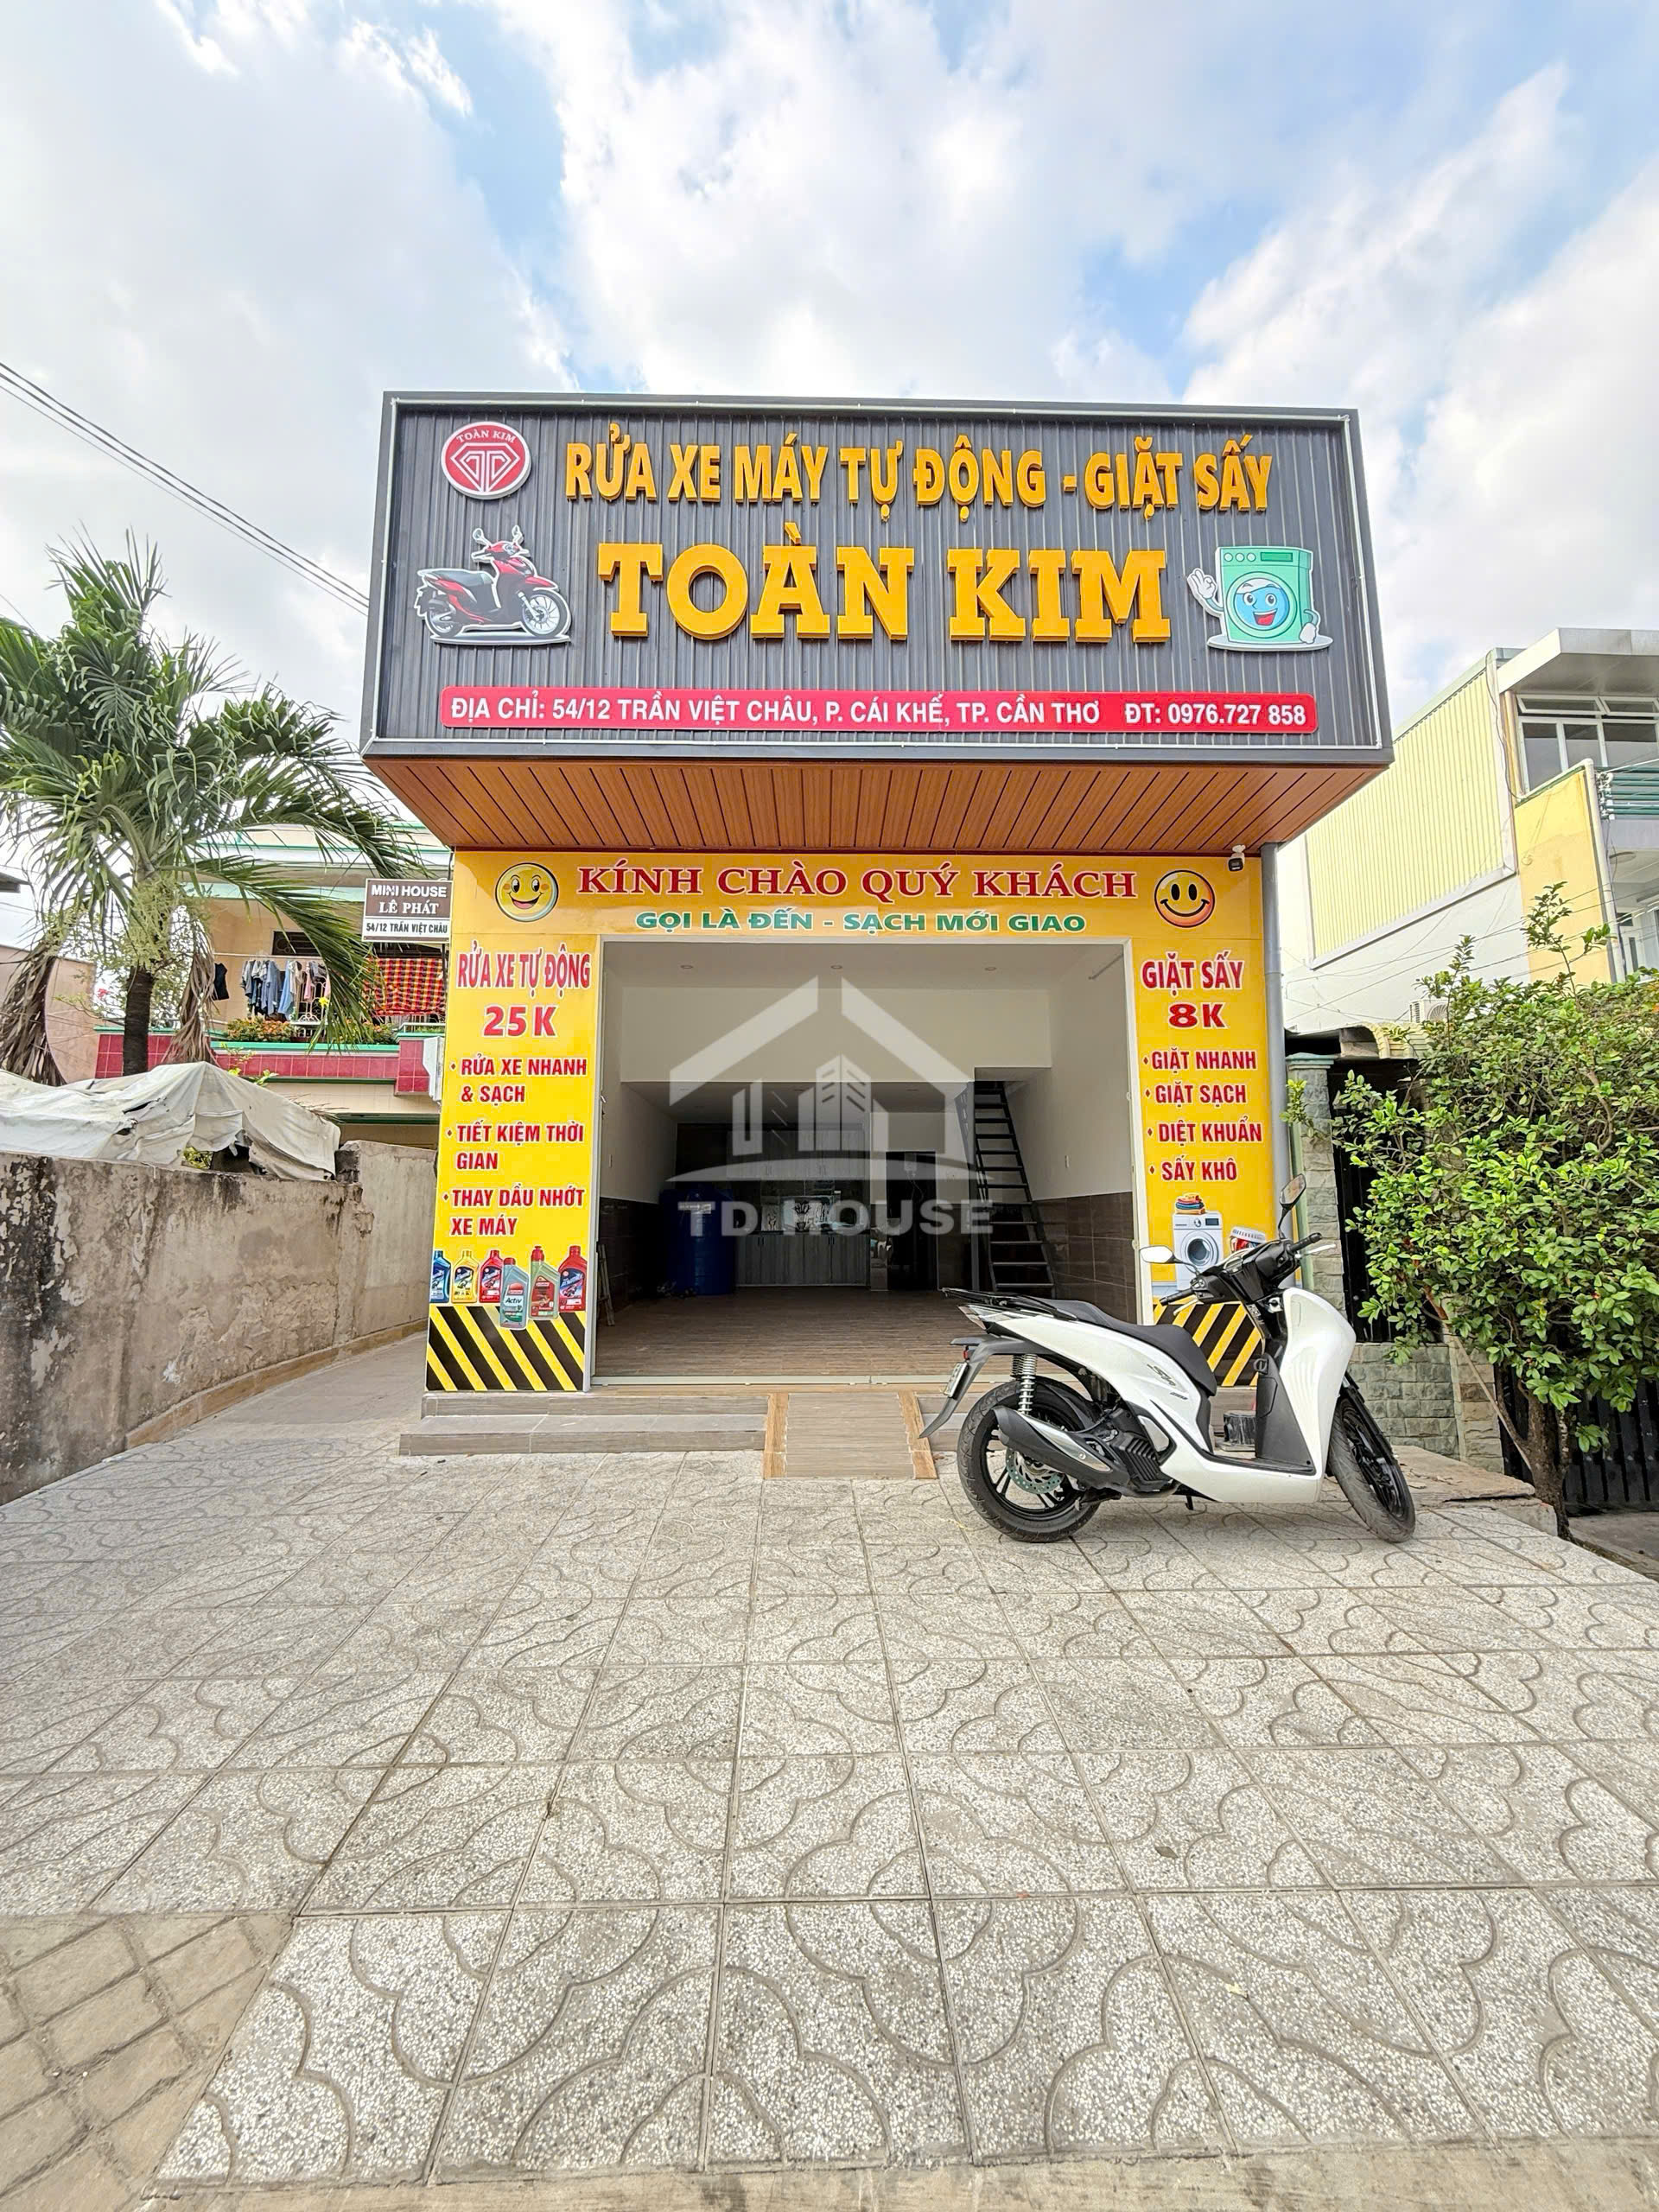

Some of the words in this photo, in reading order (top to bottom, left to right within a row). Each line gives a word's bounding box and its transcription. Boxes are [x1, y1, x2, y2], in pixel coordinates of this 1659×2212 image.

[455, 429, 489, 443] TOÀN
[493, 430, 516, 443] KIM
[565, 423, 657, 502] RỬA
[667, 443, 721, 503] XE
[734, 433, 828, 503] MÁY
[840, 441, 903, 522] TỰ
[913, 435, 1046, 524] ĐỘNG
[1085, 436, 1183, 522] GIẶT
[1194, 435, 1272, 512] SẤY
[598, 522, 914, 640] TOÀN
[948, 549, 1172, 643] KIM
[451, 697, 491, 722] ĐỊA
[498, 690, 545, 719] CHỈ:
[553, 698, 610, 720] 54/12
[618, 691, 680, 721] TRẦN
[689, 695, 740, 725] VIỆT
[747, 696, 818, 725] CHÂU,
[825, 702, 843, 722] P.
[850, 696, 888, 722] CÁI
[896, 692, 950, 727] KHẾ,
[957, 702, 989, 723] TP.
[996, 694, 1045, 723] CẦN
[1051, 701, 1101, 723] THƠ
[1125, 703, 1161, 724] ĐT:
[1168, 703, 1261, 724] 0976.727
[1268, 705, 1306, 725] 858
[372, 885, 399, 896] MINI
[401, 886, 447, 898] HOUSE
[578, 860, 702, 894] KÍNH
[717, 861, 847, 894] CHÀO
[862, 862, 958, 903] QUÝ
[973, 863, 1136, 898] KHÁCH
[379, 899, 397, 913] LÊ
[403, 899, 439, 914] PHÁT
[366, 923, 387, 932] 54/12
[411, 922, 427, 935] VIỆT
[429, 922, 448, 933] CHÂU
[636, 912, 690, 932] GỌI
[702, 908, 741, 930] LÀ
[749, 907, 812, 930] ĐẾN
[843, 913, 925, 934] SẠCH
[937, 910, 998, 932] MỚI
[1008, 915, 1085, 932] GIAO
[457, 941, 491, 988] RỬA
[494, 953, 517, 988] XE
[518, 948, 543, 997] TỰ
[544, 944, 591, 998] ĐỘNG
[1141, 951, 1195, 996] GIẶT
[1201, 951, 1243, 990] SẤY
[461, 1053, 495, 1076] RỬA
[500, 1058, 522, 1076] XE
[528, 1058, 587, 1076] NHANH
[1151, 1046, 1189, 1073] GIẶT
[1196, 1051, 1256, 1070] NHANH
[461, 1086, 474, 1103] &
[480, 1085, 524, 1106] SẠCH
[1155, 1081, 1193, 1107] GIẶT
[1200, 1084, 1247, 1107] SẠCH
[456, 1121, 492, 1142] TIẾT
[497, 1122, 539, 1145] KIỆM
[546, 1121, 583, 1142] THỜI
[1158, 1120, 1195, 1146] DIỆT
[1202, 1116, 1262, 1142] KHUẨN
[456, 1152, 498, 1170] GIAN
[1161, 1155, 1195, 1181] SẤY
[1202, 1158, 1237, 1180] KHÔ
[452, 1189, 493, 1207] THAY
[499, 1184, 533, 1207] DẦU
[539, 1185, 585, 1207] NHỚT
[450, 1217, 476, 1236] XE
[479, 1214, 517, 1236] MÁY
